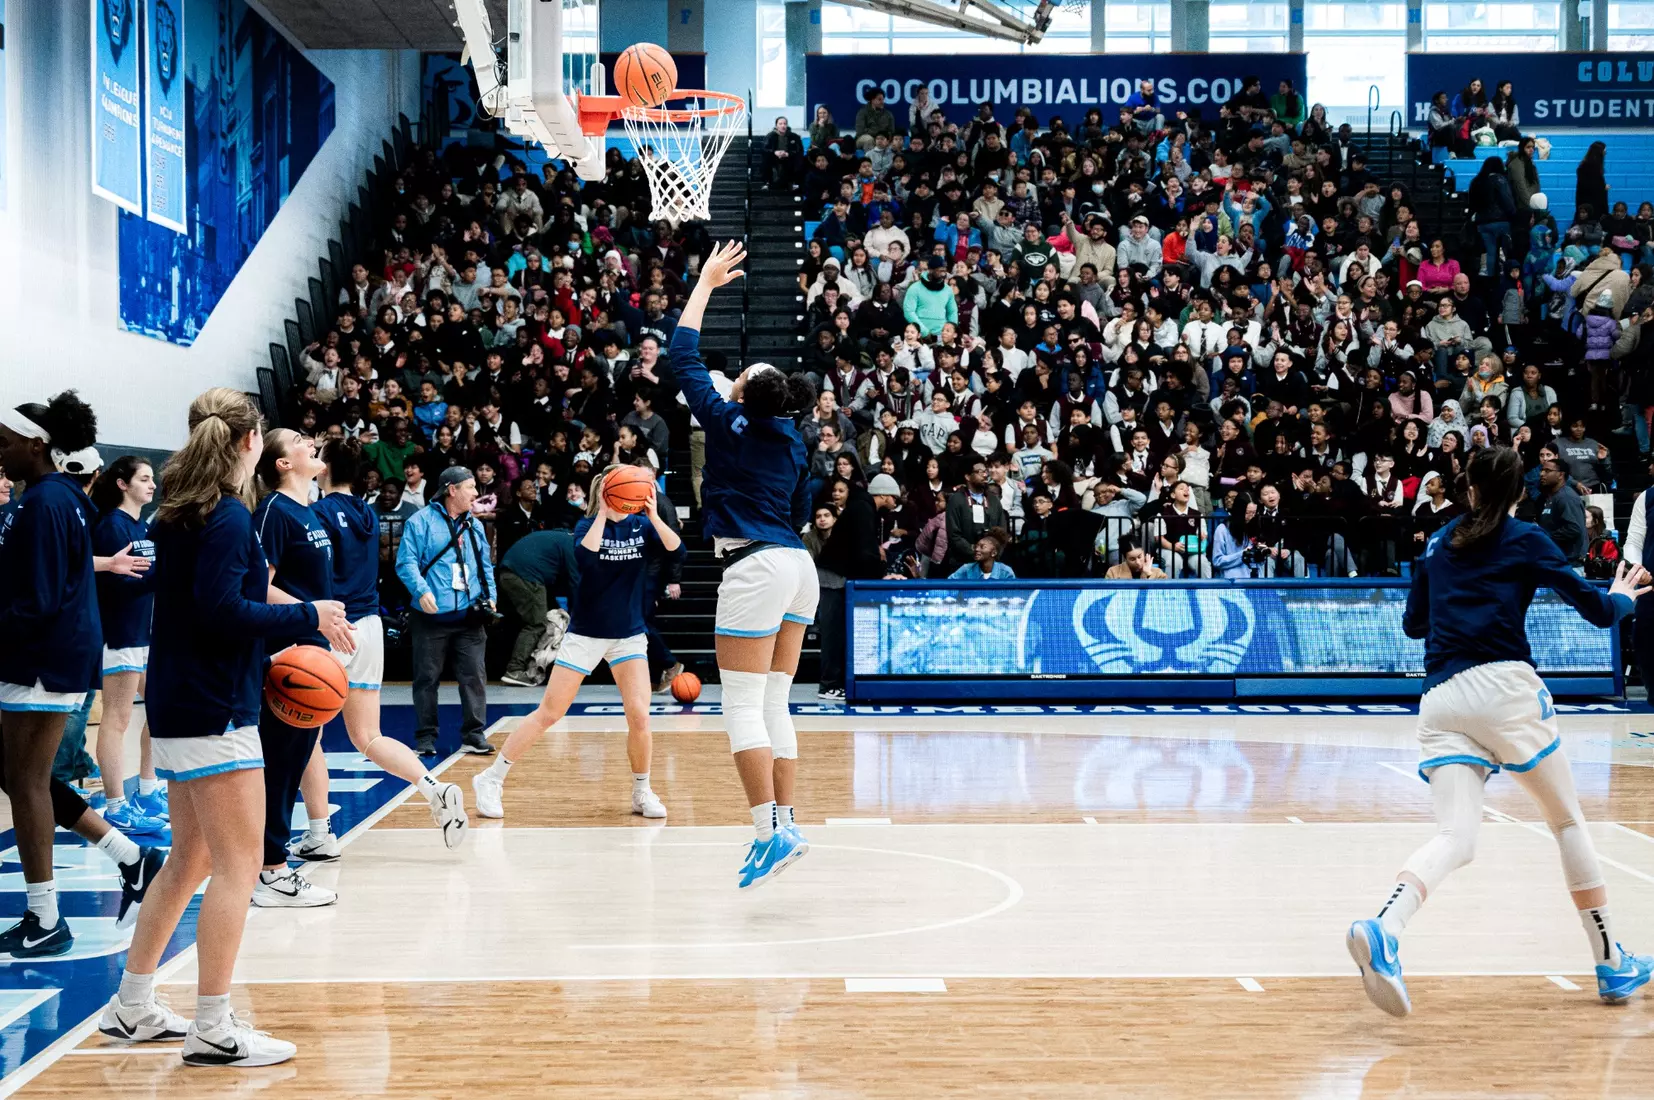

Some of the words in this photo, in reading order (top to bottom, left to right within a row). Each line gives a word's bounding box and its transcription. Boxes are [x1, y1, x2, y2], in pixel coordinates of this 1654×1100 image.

[731, 415, 749, 435] C
[921, 423, 946, 441] GAP
[336, 511, 348, 528] C
